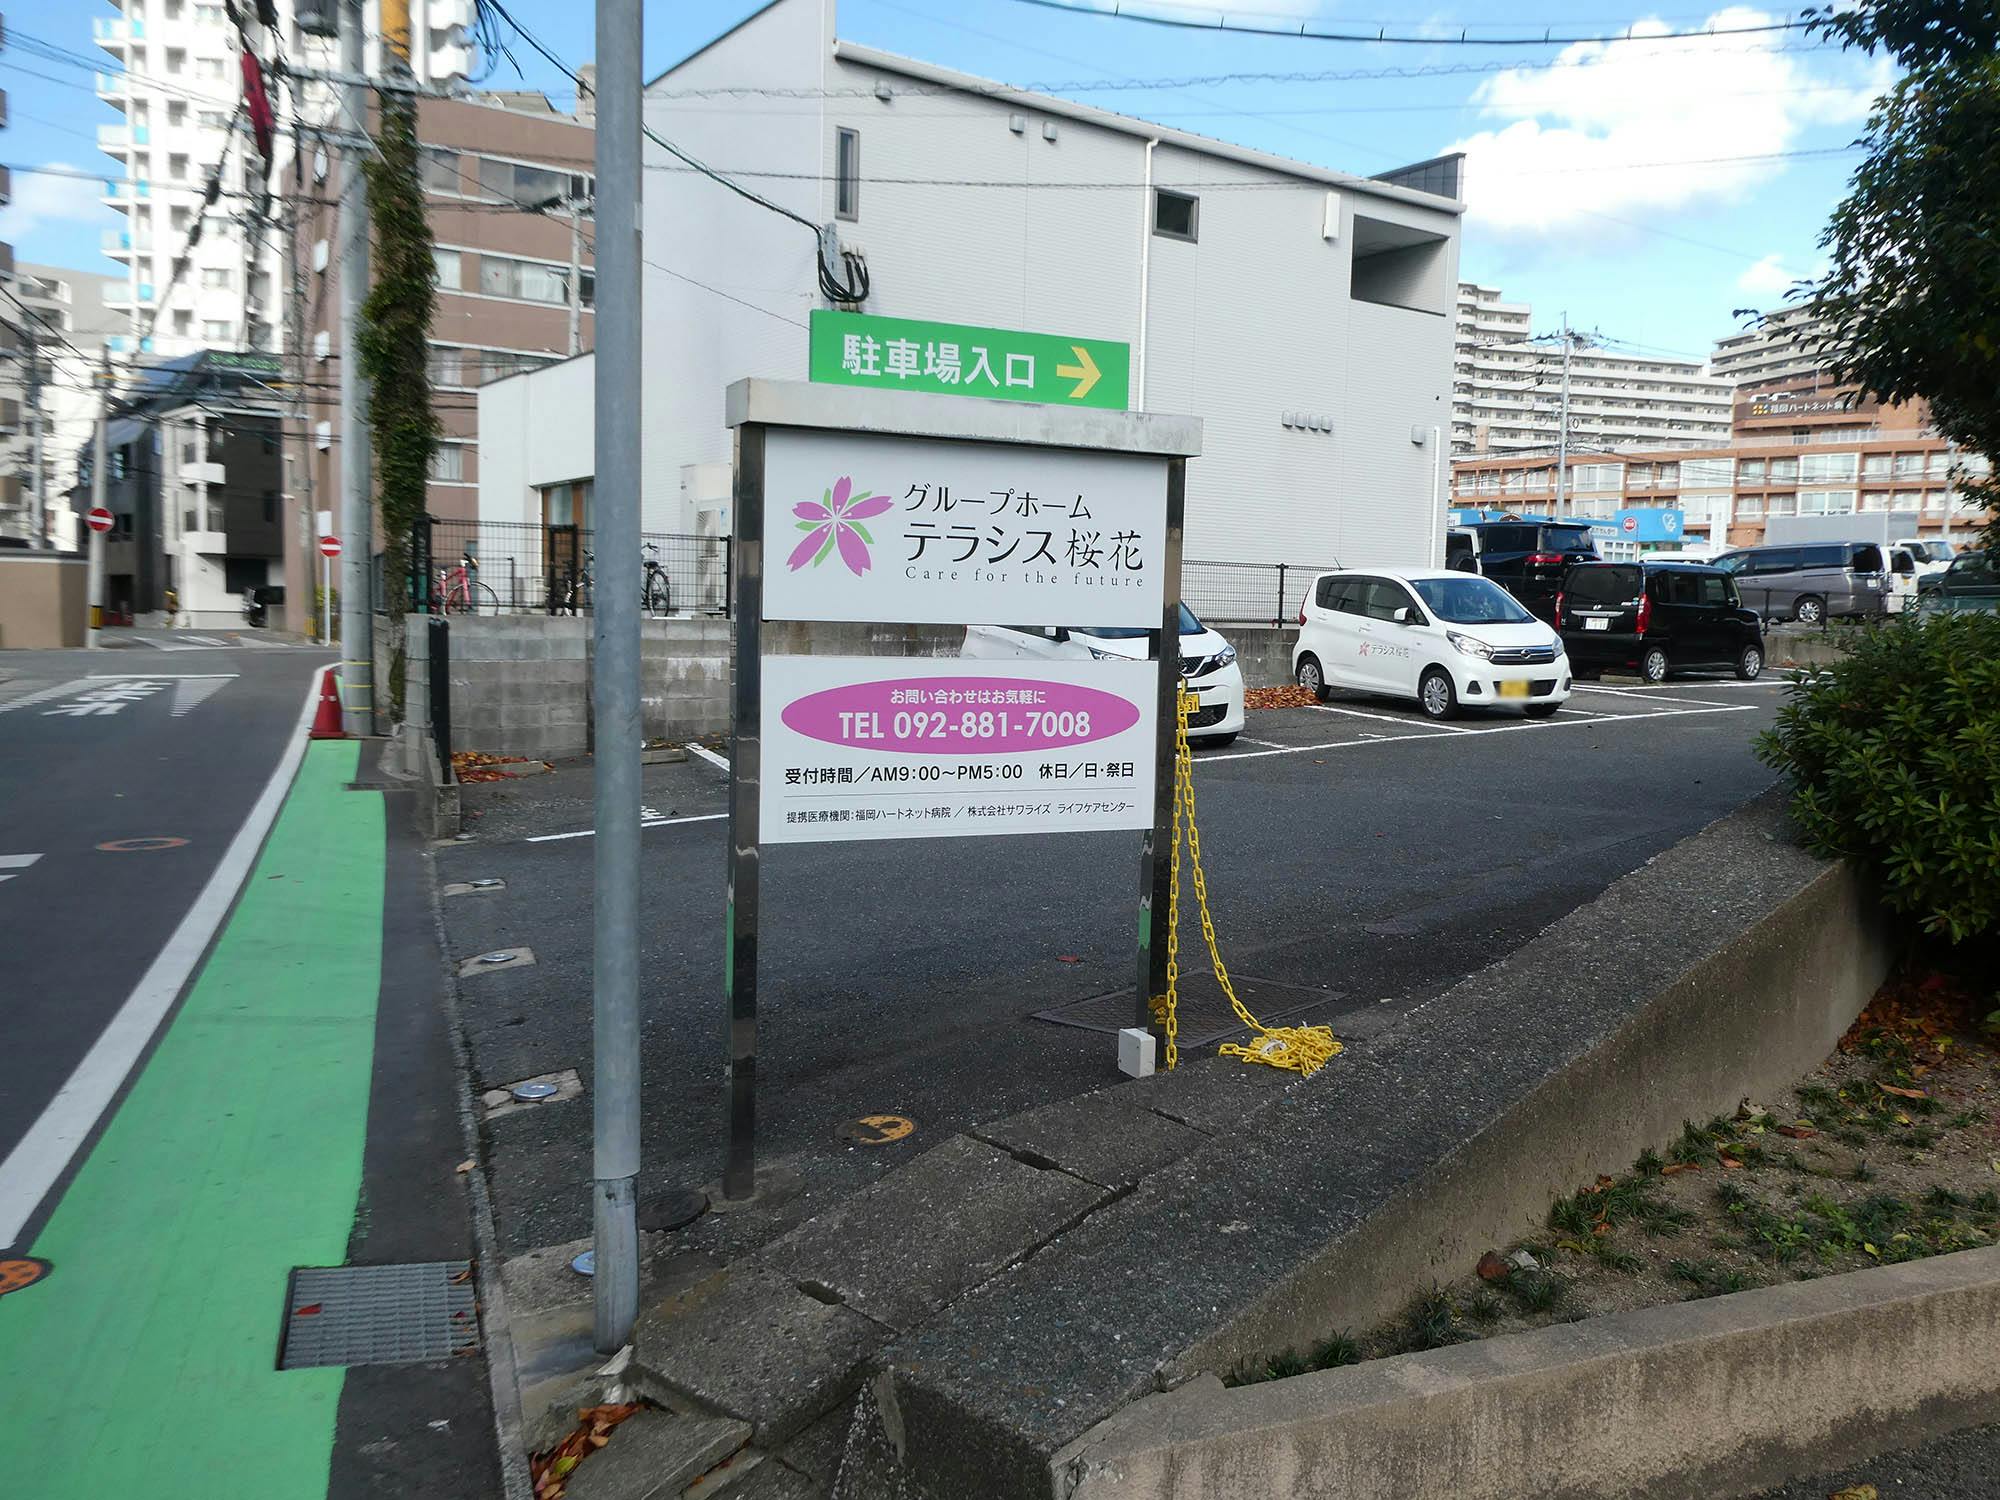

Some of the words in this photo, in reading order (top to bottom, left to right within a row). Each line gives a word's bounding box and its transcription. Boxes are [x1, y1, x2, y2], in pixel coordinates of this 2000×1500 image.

[842, 333, 1036, 389] 駐車場入口
[904, 483, 1092, 519] グループホーム
[903, 523, 1144, 572] テラシス桜花
[905, 566, 958, 581] Care
[975, 568, 1008, 582] for
[1025, 570, 1058, 584] the
[1074, 571, 1143, 587] future
[890, 688, 1046, 705] お問い合わせはお気軽に
[839, 711, 885, 739] TEL
[893, 711, 1091, 739] 092-881-7008
[1057, 801, 1135, 815] ライフケアセンター
